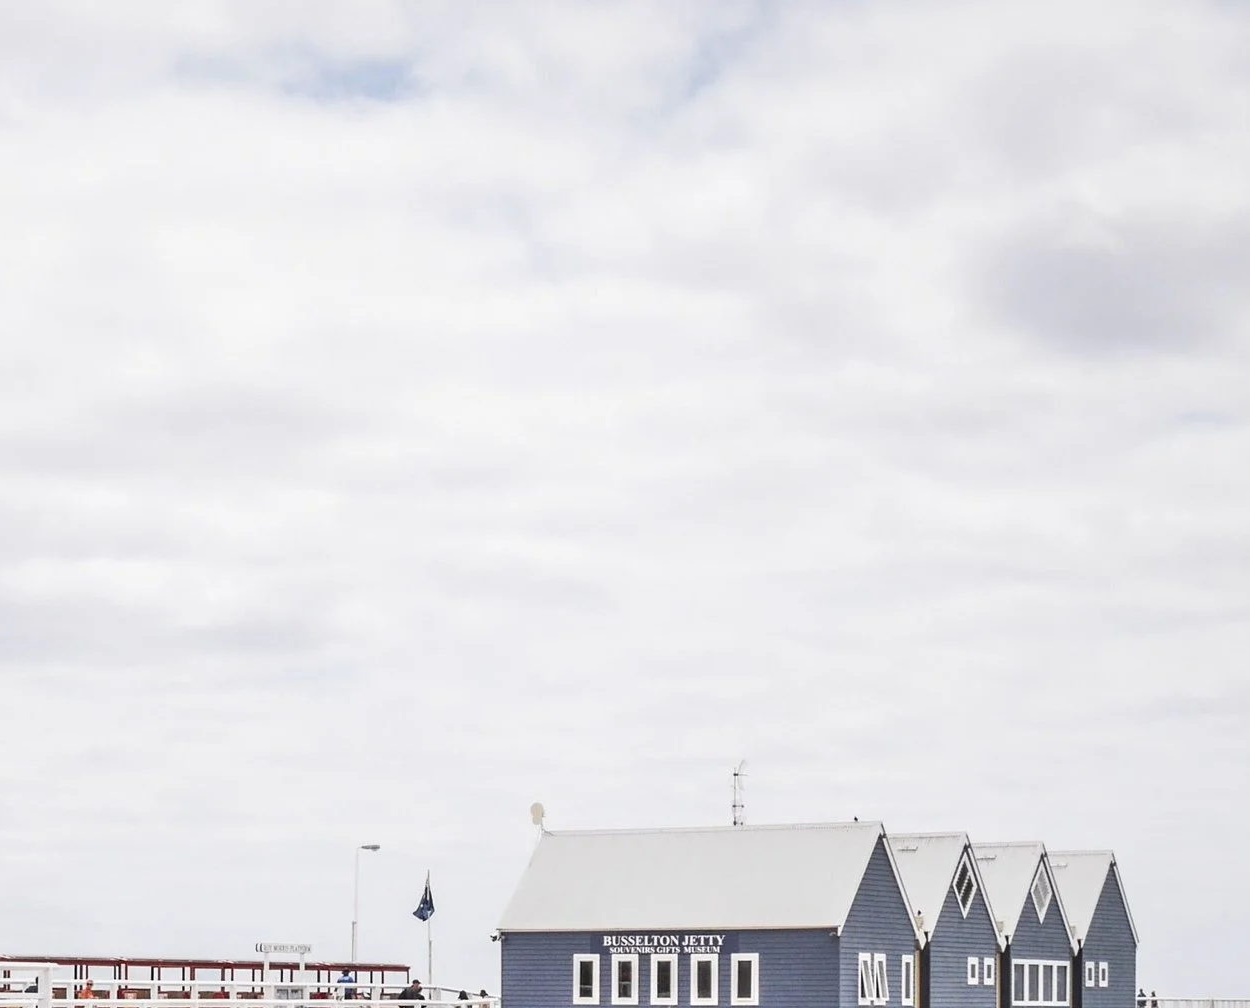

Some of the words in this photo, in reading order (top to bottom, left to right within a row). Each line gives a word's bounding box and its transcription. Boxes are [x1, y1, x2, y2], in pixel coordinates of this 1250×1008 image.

[603, 935, 680, 946] BUSSELTON
[682, 935, 726, 946] JETTY
[609, 946, 656, 954] SOUVENIRS
[656, 946, 681, 954] GIFTS
